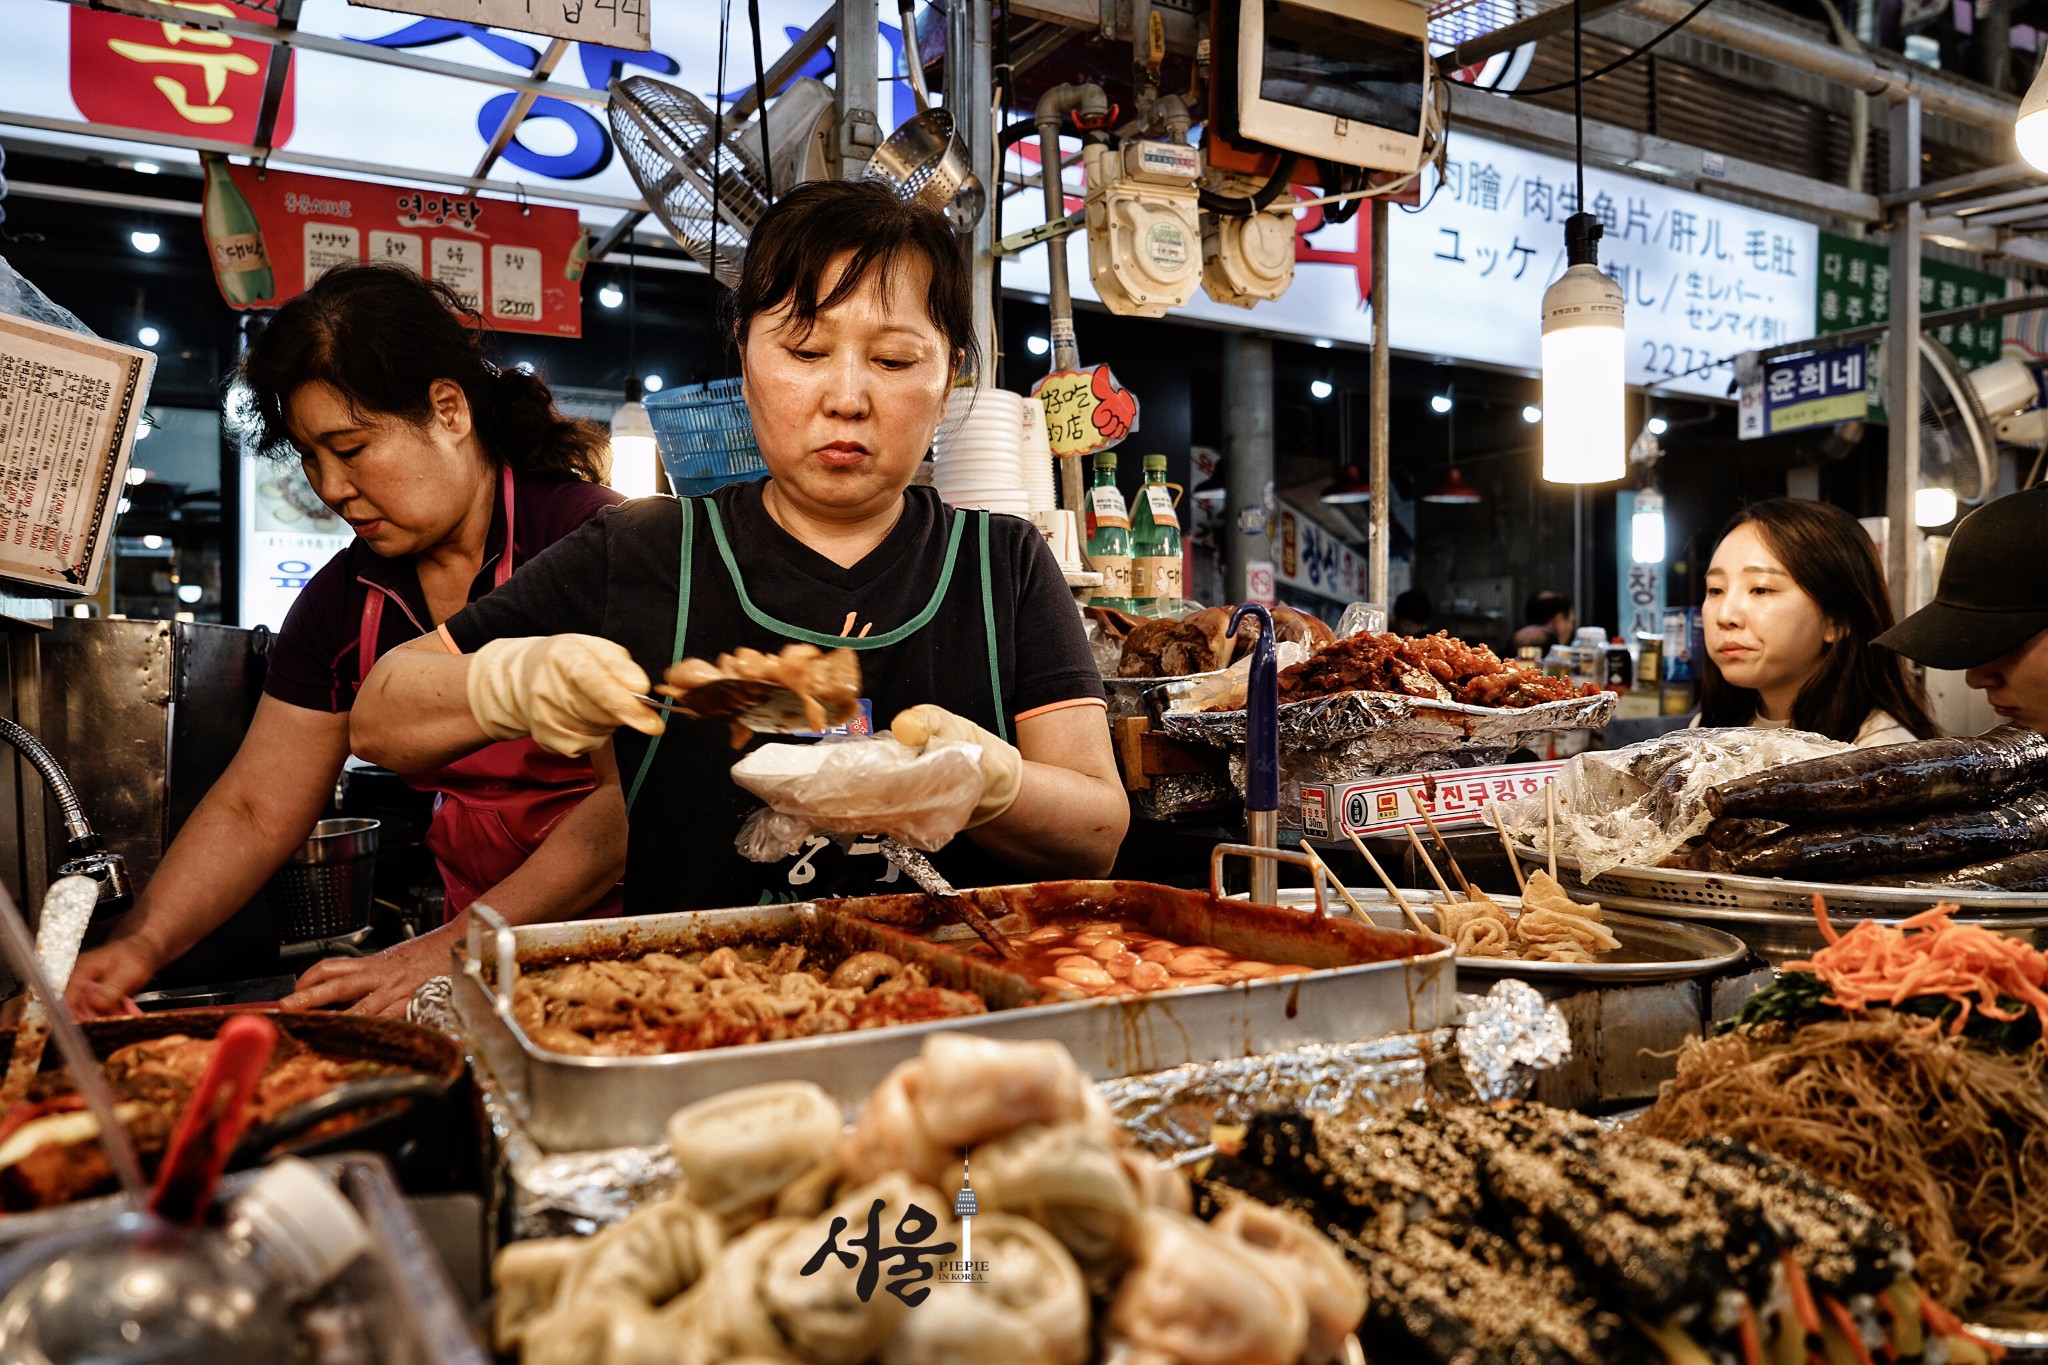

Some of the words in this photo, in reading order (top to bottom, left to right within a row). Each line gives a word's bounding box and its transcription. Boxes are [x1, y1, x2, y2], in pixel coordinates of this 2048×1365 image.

[397, 193, 482, 228] 영양탕
[1434, 227, 1538, 280] ユッケ
[0, 355, 16, 386] 순대고기
[15, 360, 32, 390] 머리고기
[32, 363, 48, 394] 찹쌀순대
[1767, 353, 1862, 403] 윤희네
[79, 376, 96, 407] 곱창볶음
[95, 382, 111, 411] 마약김밥
[1041, 383, 1091, 415] 好吃
[6, 481, 20, 504] 7,000
[22, 481, 37, 508] 10,000
[53, 493, 67, 515] 7,000
[3, 507, 14, 516] 大
[19, 511, 30, 519] 大
[50, 518, 60, 526] 大
[13, 520, 27, 545] 13,000
[29, 523, 43, 549] 13,000
[44, 527, 58, 552] 10,000
[58, 533, 73, 555] 3,000
[1308, 817, 1324, 830] 30m
